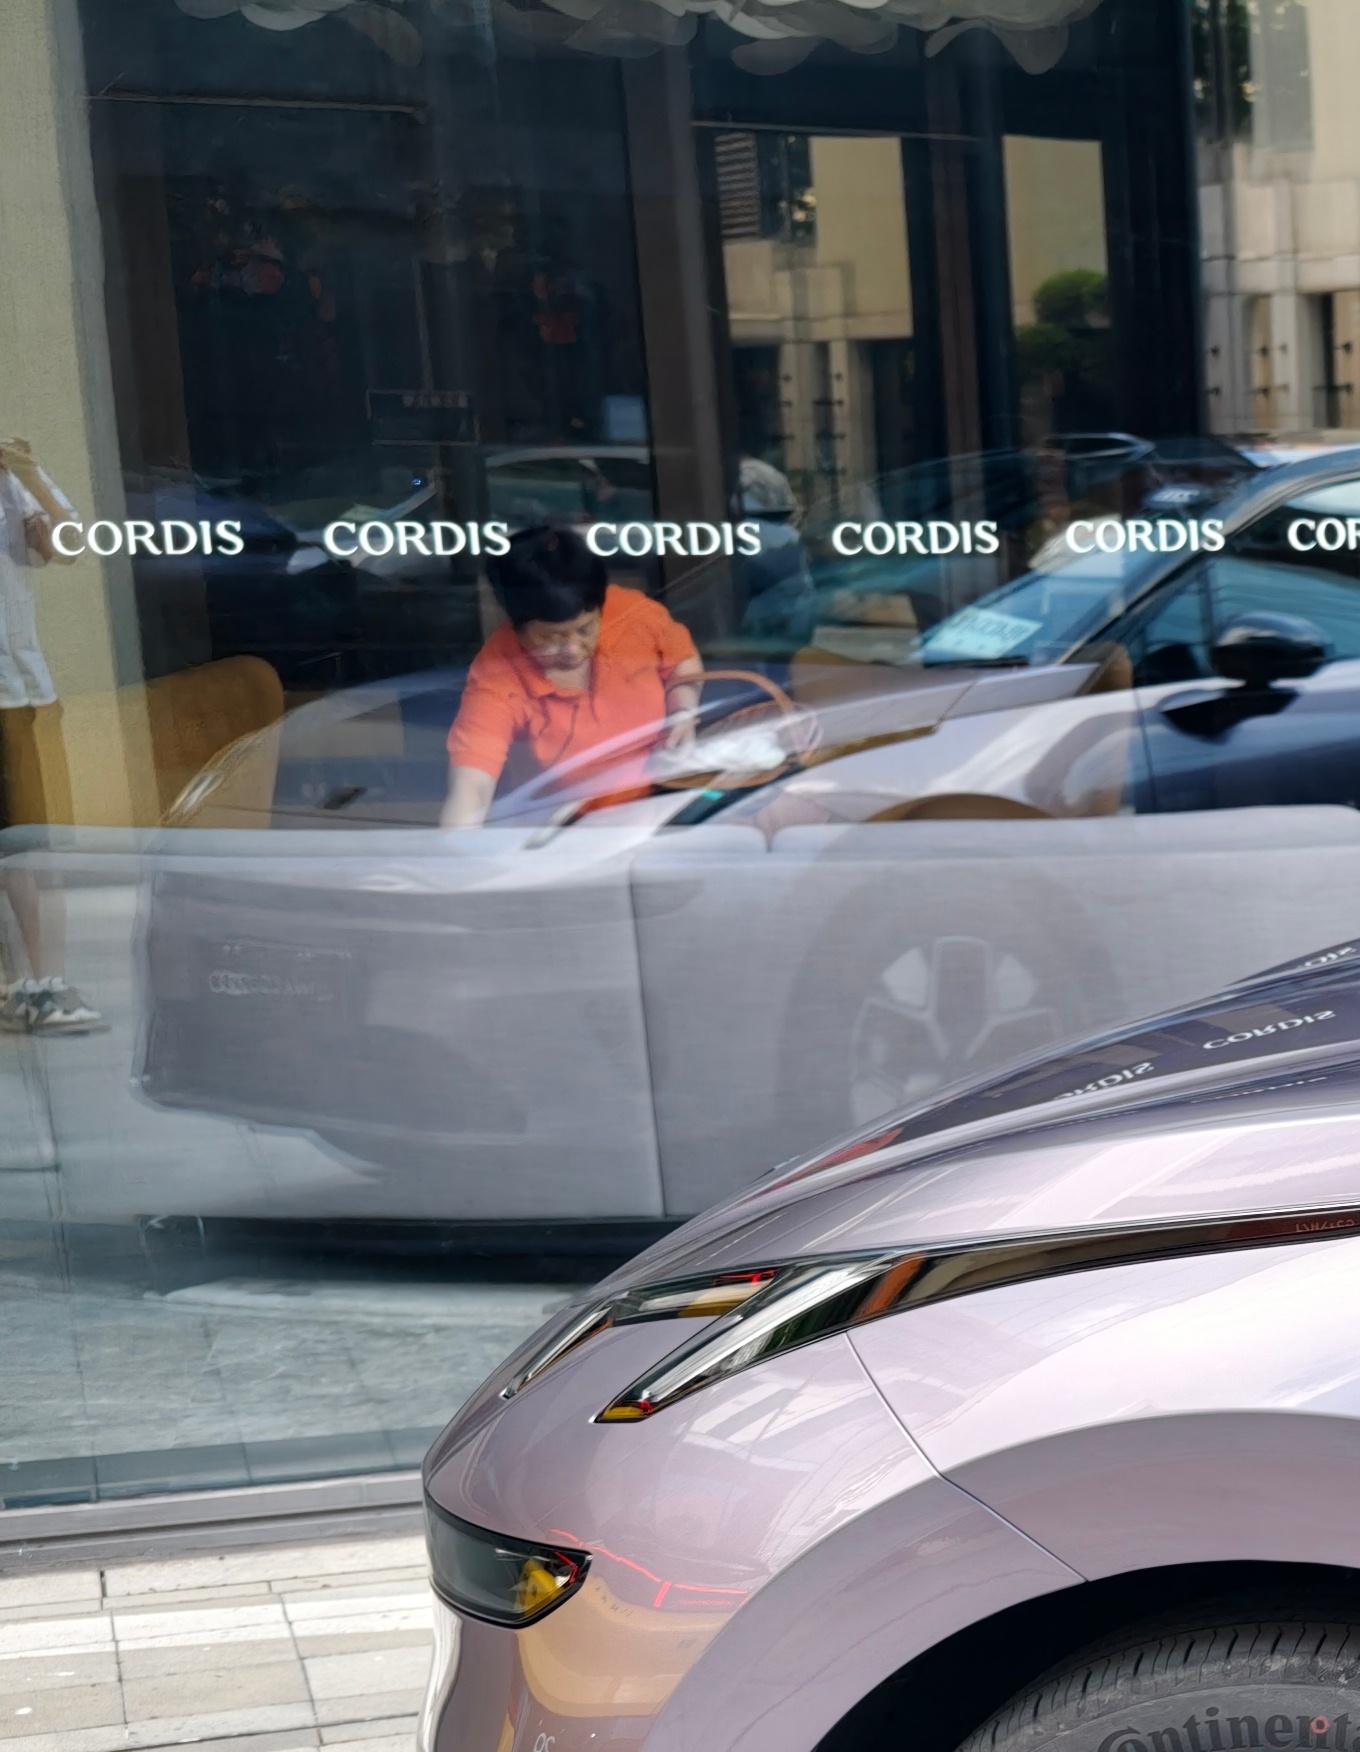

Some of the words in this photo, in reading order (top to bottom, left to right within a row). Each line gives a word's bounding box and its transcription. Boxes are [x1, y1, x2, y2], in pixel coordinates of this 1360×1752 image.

[52, 520, 245, 556] CORDIS
[324, 520, 511, 556] CORDIS
[586, 521, 762, 556] CORDIS
[832, 520, 999, 555] CORDIS
[1065, 518, 1225, 553] CORDIS
